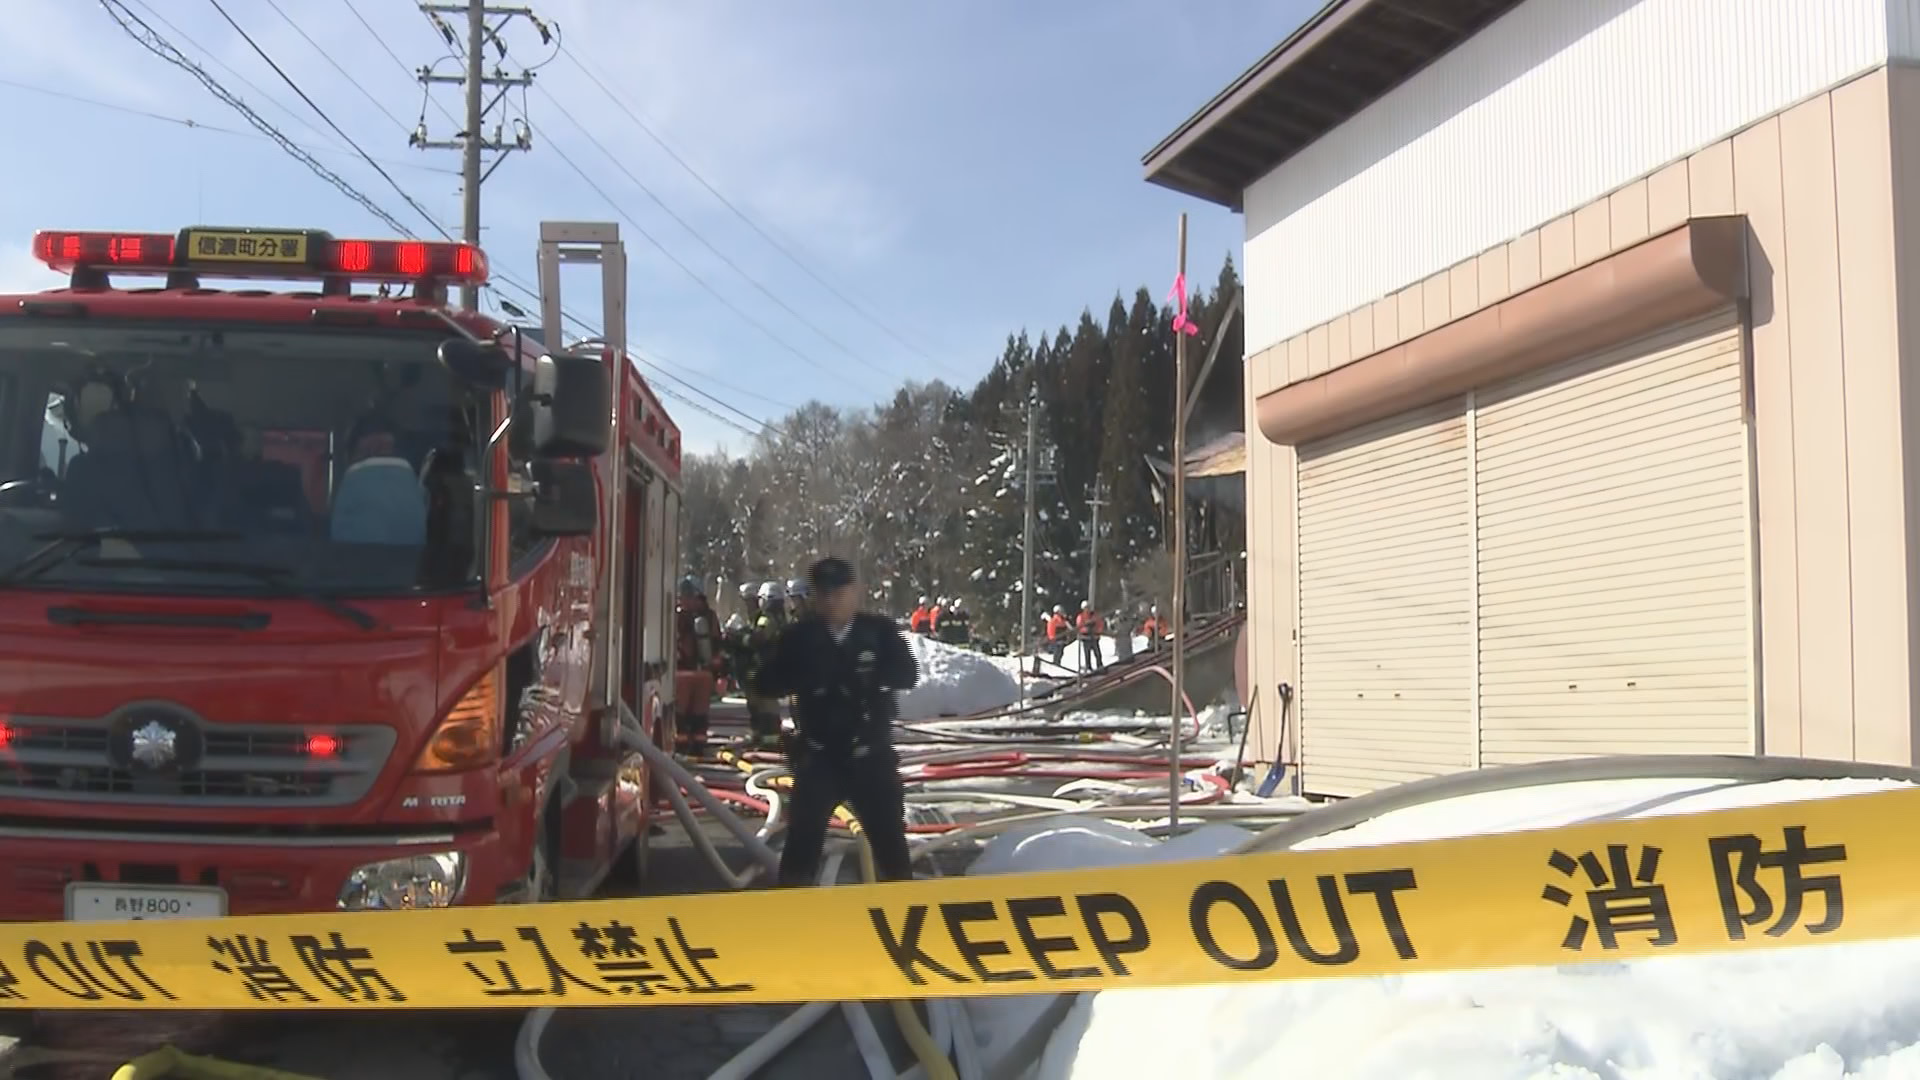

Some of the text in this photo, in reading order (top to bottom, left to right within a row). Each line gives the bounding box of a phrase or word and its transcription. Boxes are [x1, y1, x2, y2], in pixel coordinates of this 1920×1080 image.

[198, 236, 298, 257] 信濃町分署
[402, 795, 466, 808] MRITA
[23, 940, 180, 1001] OUT
[207, 932, 407, 1002] 消防
[445, 917, 754, 996] 立入禁止
[868, 894, 1151, 985] KEEP
[1189, 868, 1418, 970] OUT
[1541, 825, 1847, 950] 消防
